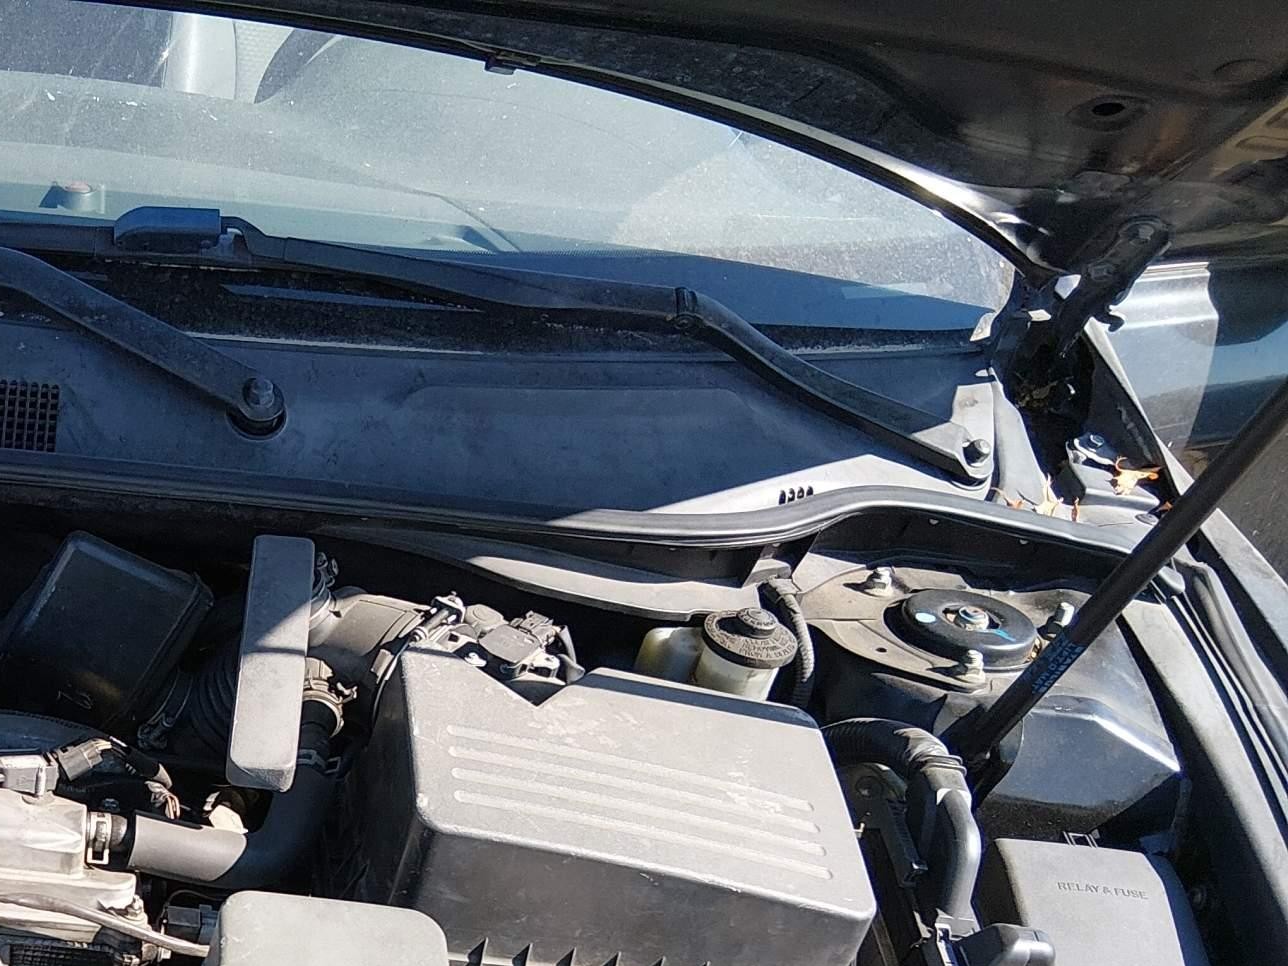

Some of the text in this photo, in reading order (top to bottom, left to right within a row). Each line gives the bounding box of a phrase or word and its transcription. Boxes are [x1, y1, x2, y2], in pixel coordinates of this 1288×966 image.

[1057, 881, 1149, 900] RELAY & FUSE
